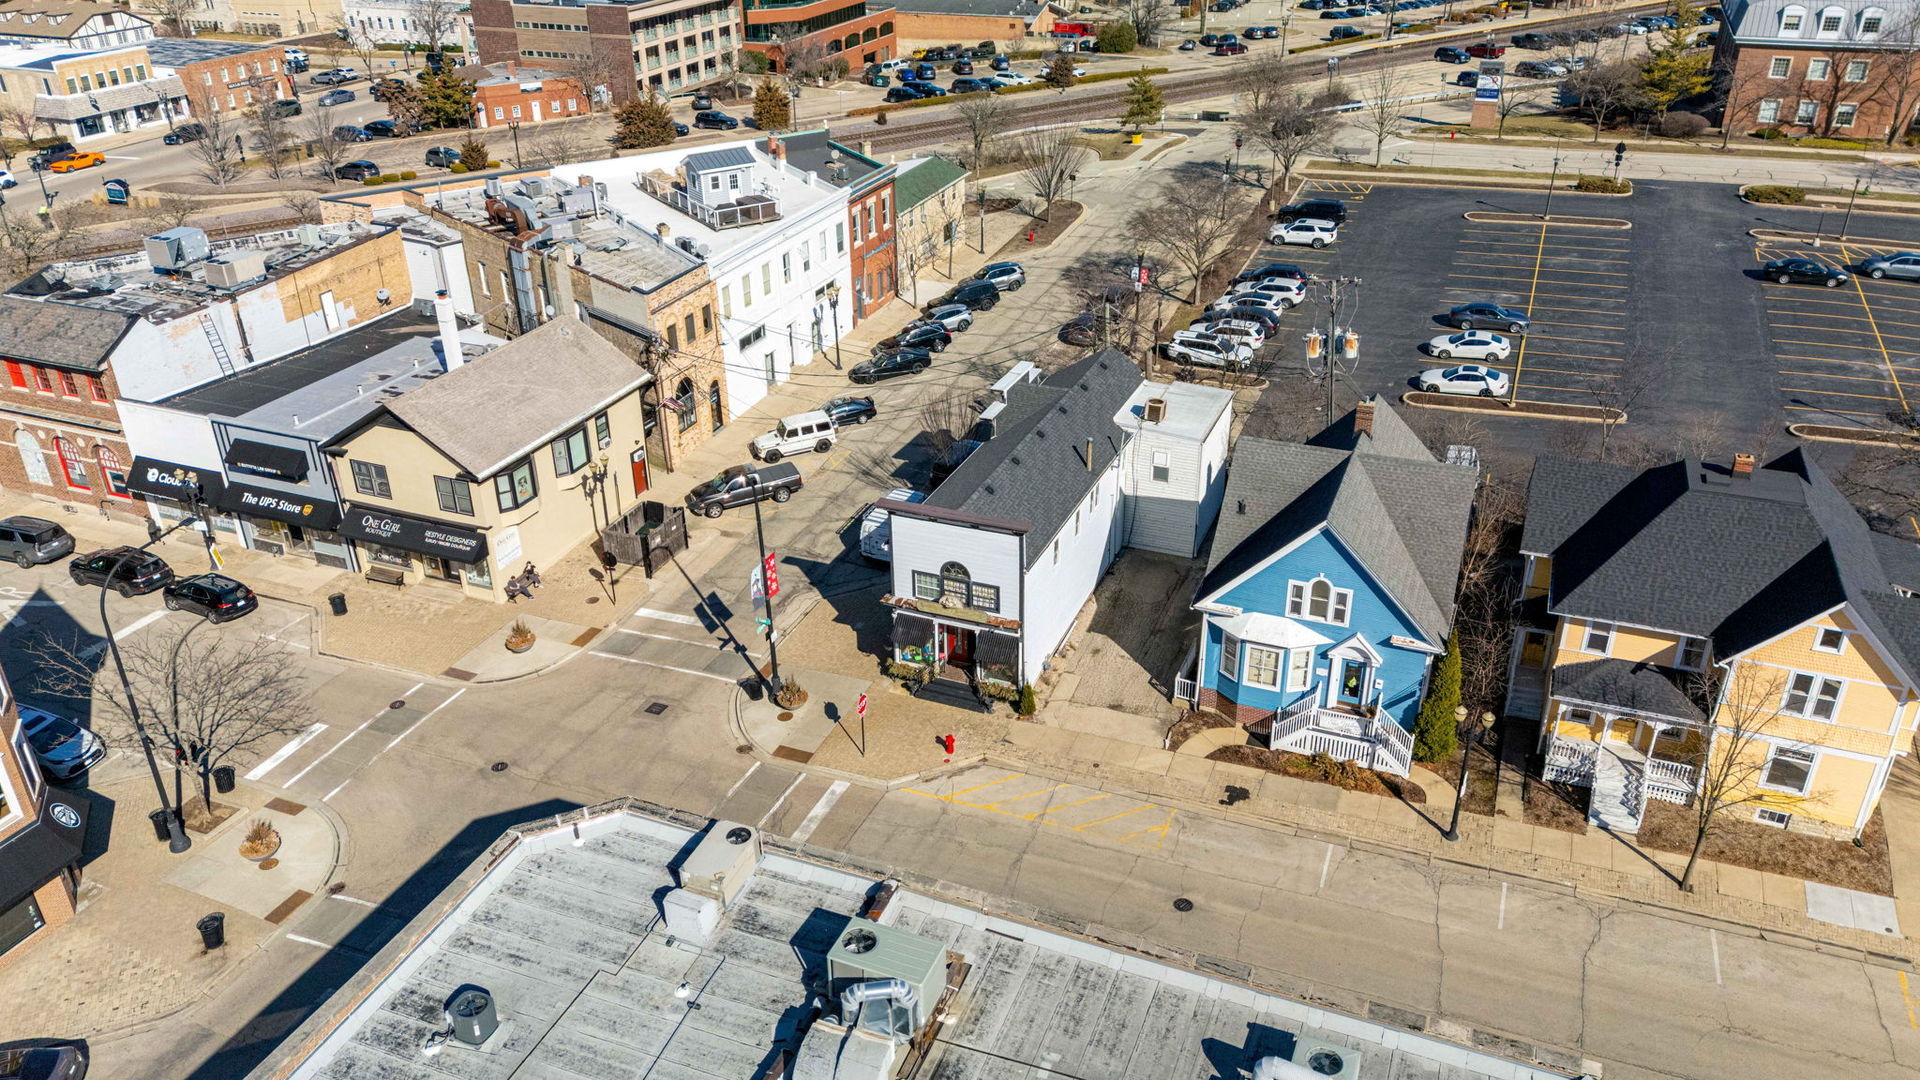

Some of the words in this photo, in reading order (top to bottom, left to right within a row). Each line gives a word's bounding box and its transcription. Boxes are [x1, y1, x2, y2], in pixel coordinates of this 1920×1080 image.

[242, 492, 258, 505] The
[258, 496, 276, 509] UPS
[277, 500, 301, 514] Store
[380, 518, 400, 534] GIRL
[424, 530, 446, 540] RESTYLE
[446, 534, 478, 547] DESIGNERS
